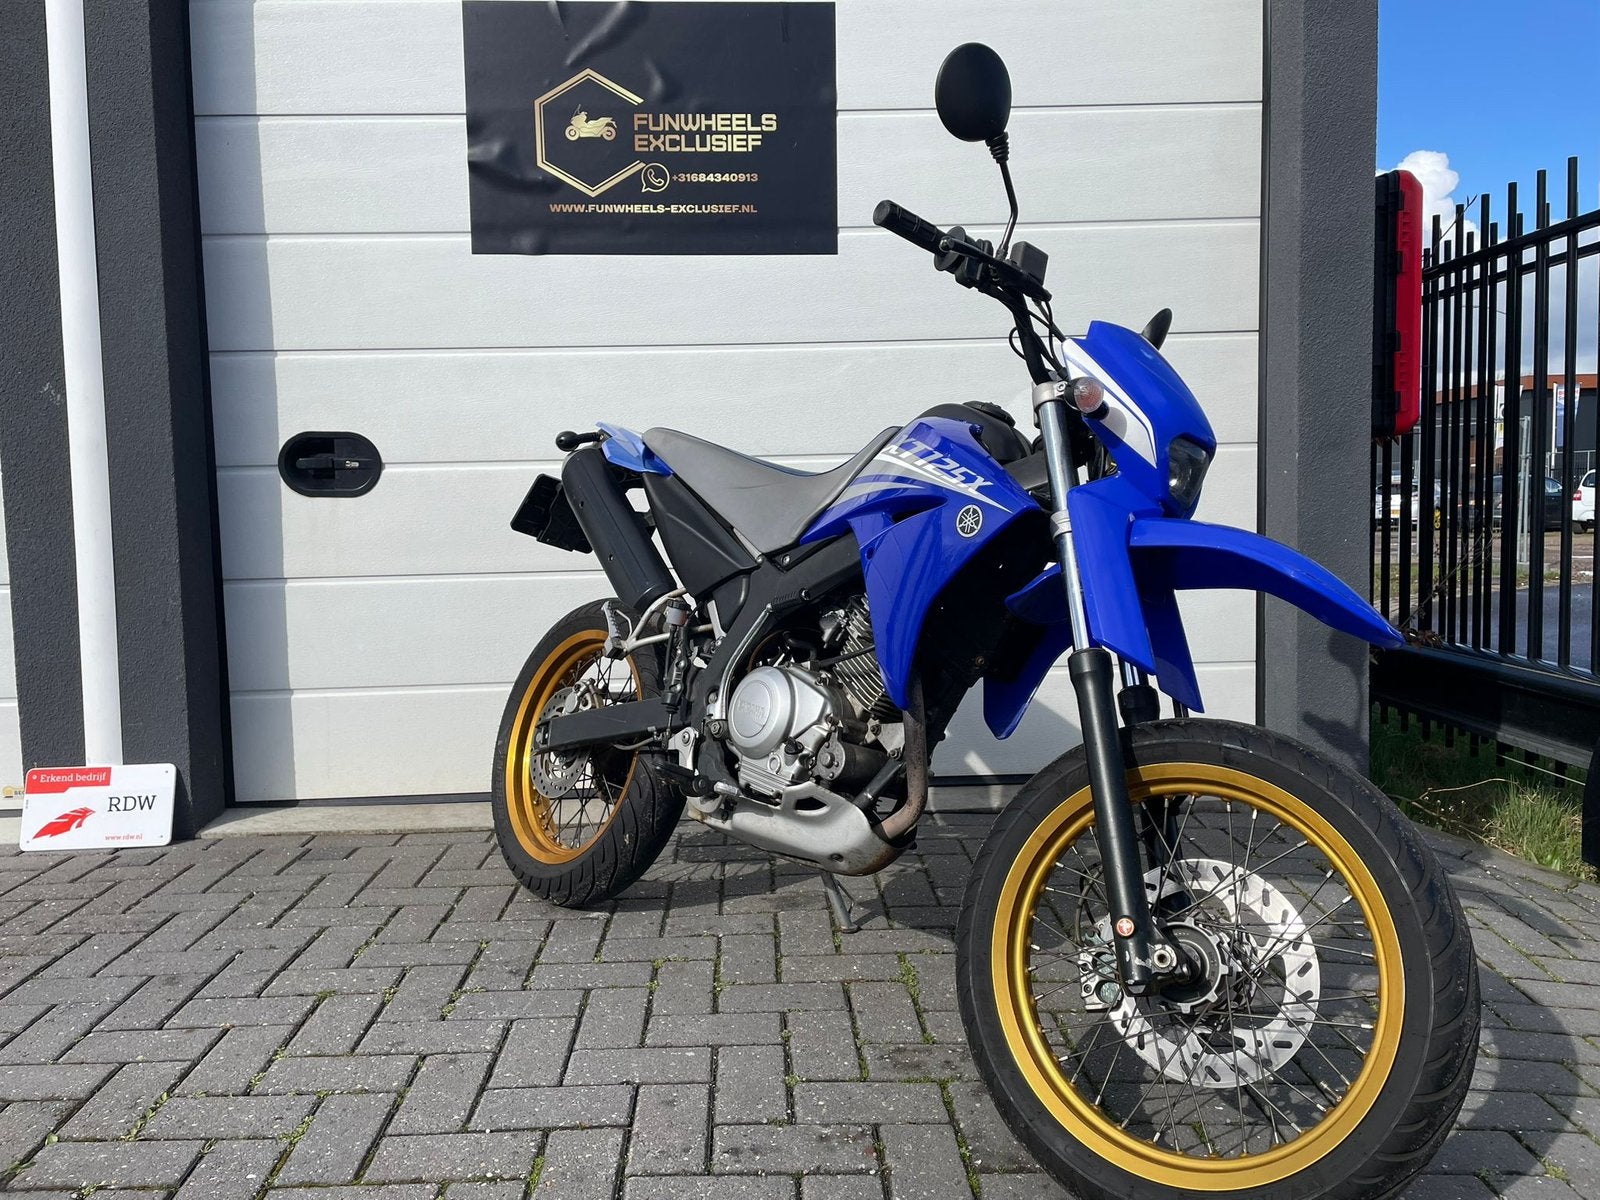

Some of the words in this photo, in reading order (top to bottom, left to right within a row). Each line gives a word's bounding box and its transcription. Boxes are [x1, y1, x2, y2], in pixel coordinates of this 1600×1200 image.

[633, 113, 778, 131] FUNWHEELS
[634, 134, 762, 152] EXCLUSIEF
[671, 172, 759, 182] +31684340913
[549, 203, 758, 214] WWW.FUNWHEELS-EXCLUSIEF.NL
[40, 774, 74, 783] Erkend
[75, 771, 107, 783] bedrijf
[107, 795, 157, 812] RDW
[105, 833, 143, 841] www.rdw.nl
